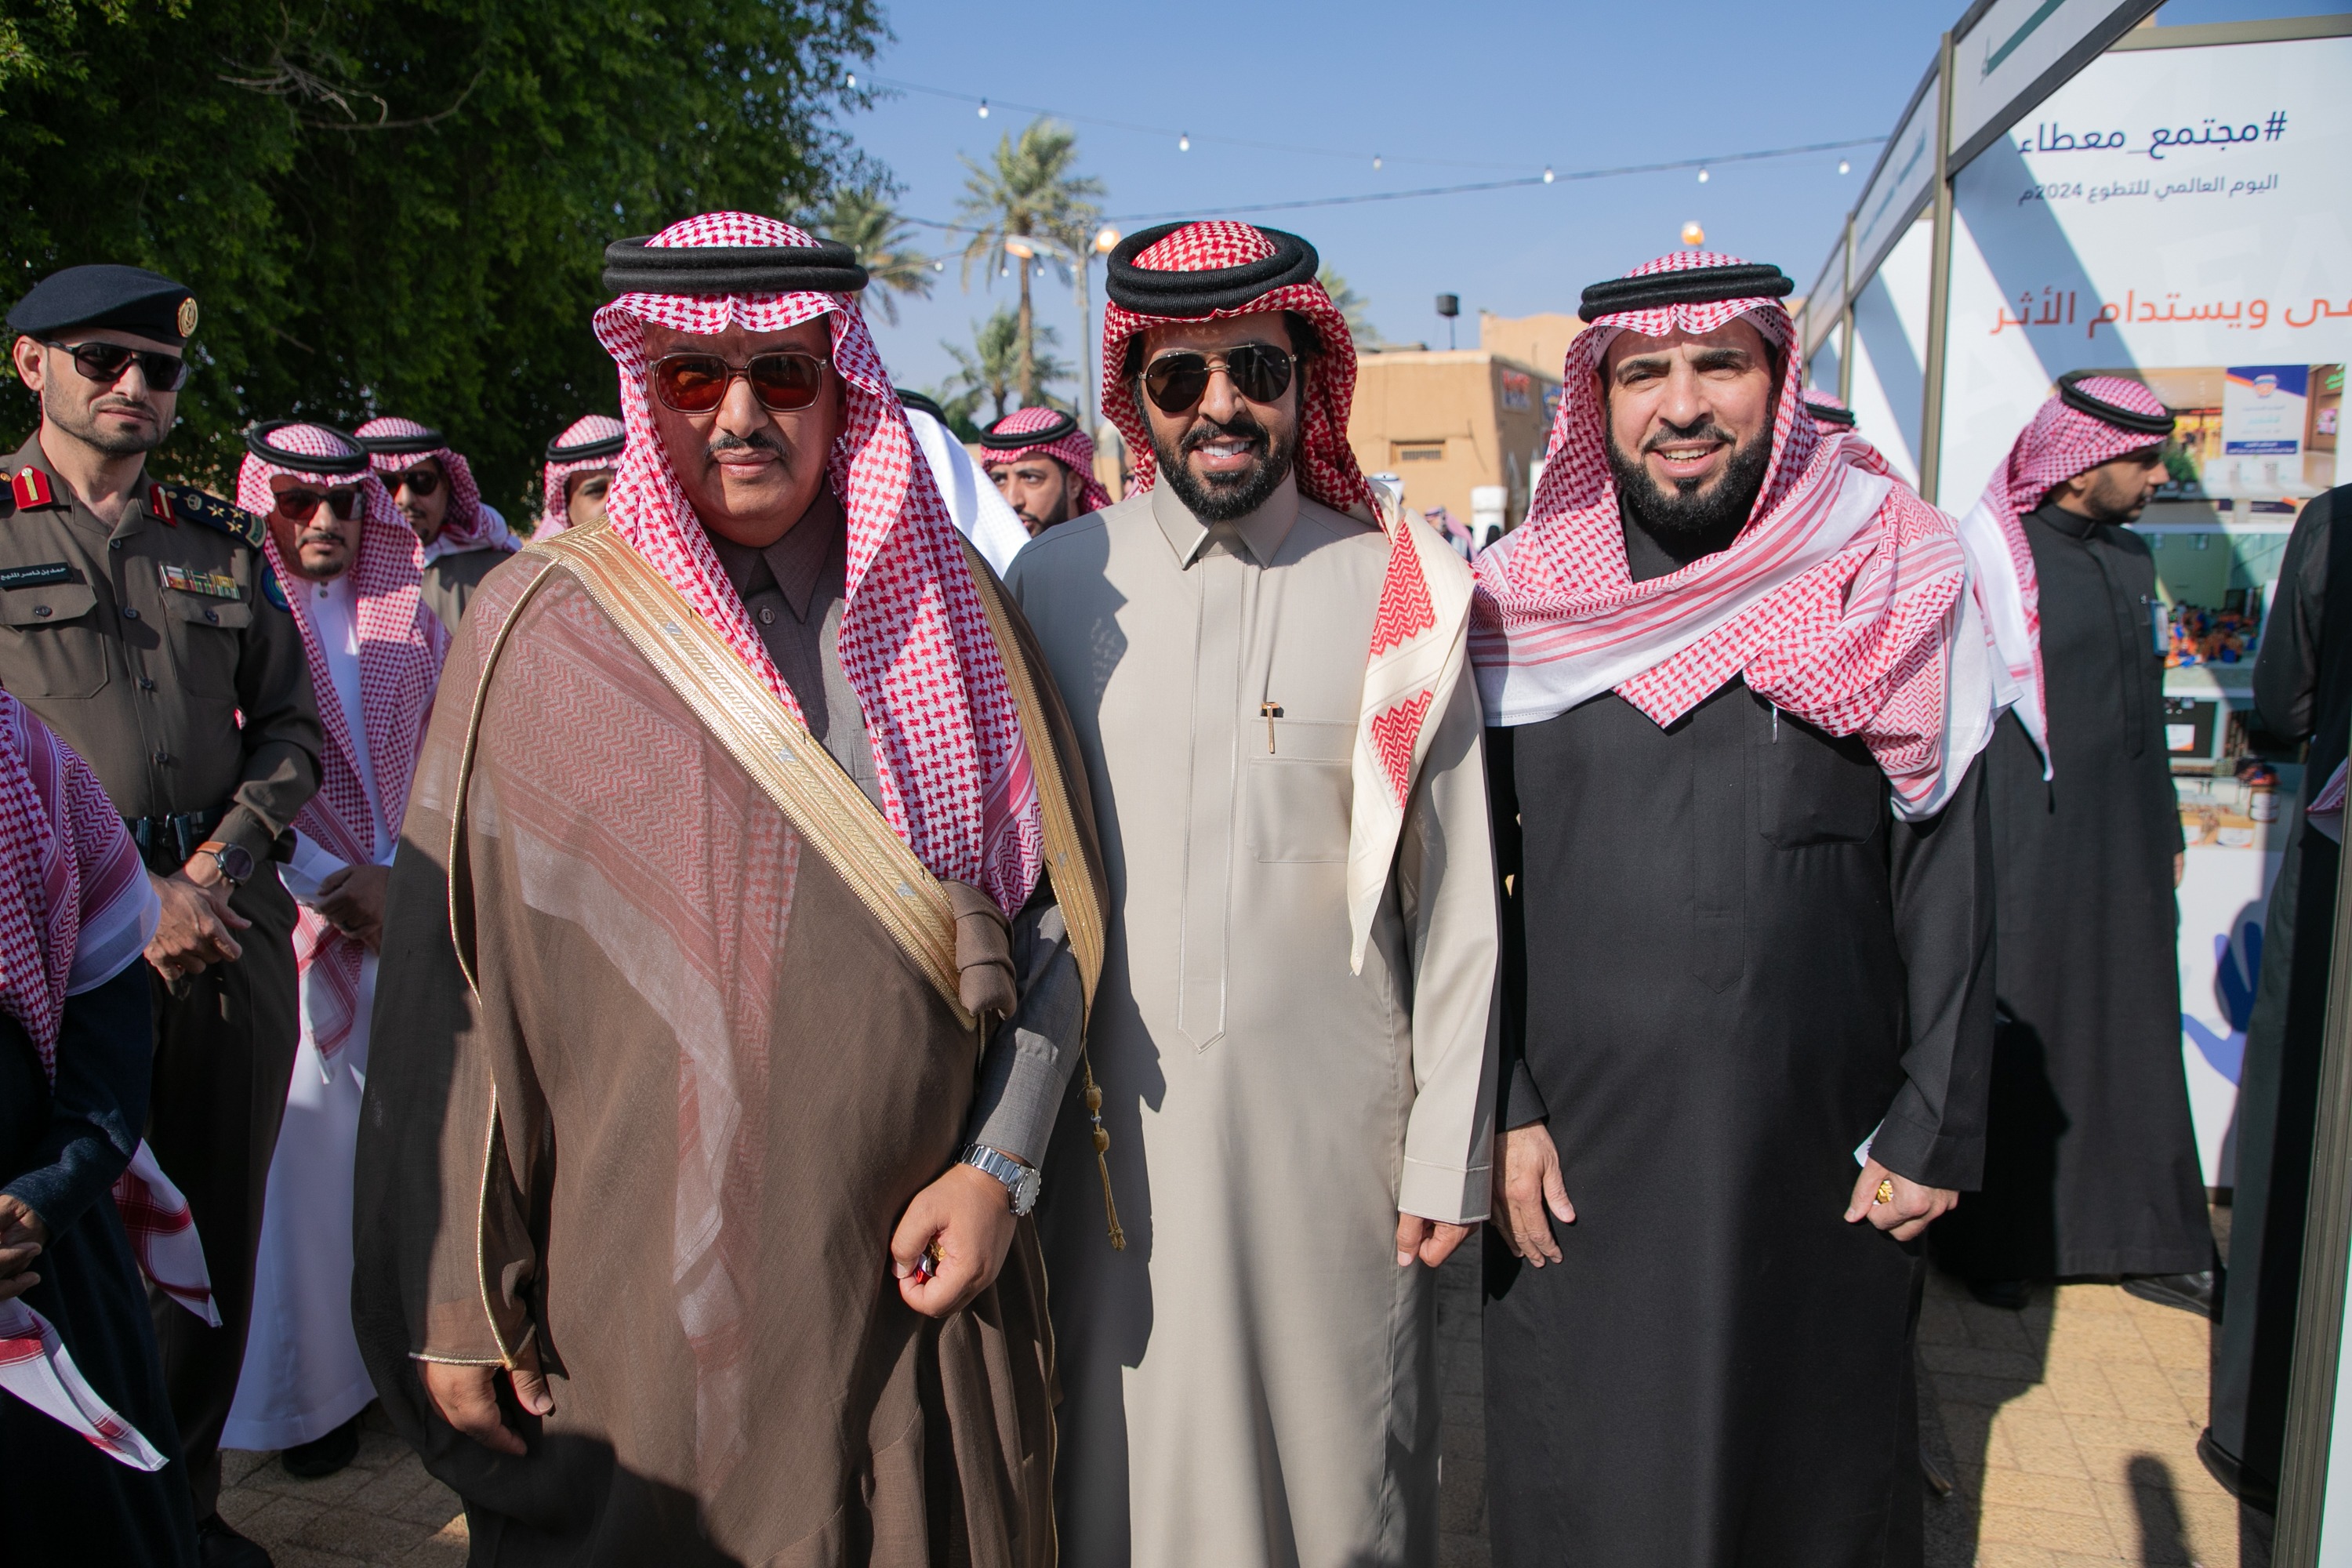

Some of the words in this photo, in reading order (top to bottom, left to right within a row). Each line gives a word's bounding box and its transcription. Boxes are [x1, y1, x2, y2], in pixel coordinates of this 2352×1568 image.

[2017, 111, 2287, 160] #مجتمع_معطاء
[2087, 180, 2149, 205] للتطوع
[2154, 176, 2225, 202] العالمي
[2229, 173, 2278, 198] اليوم
[1991, 285, 2076, 335] الأثر
[2089, 289, 2269, 339] ويستدام
